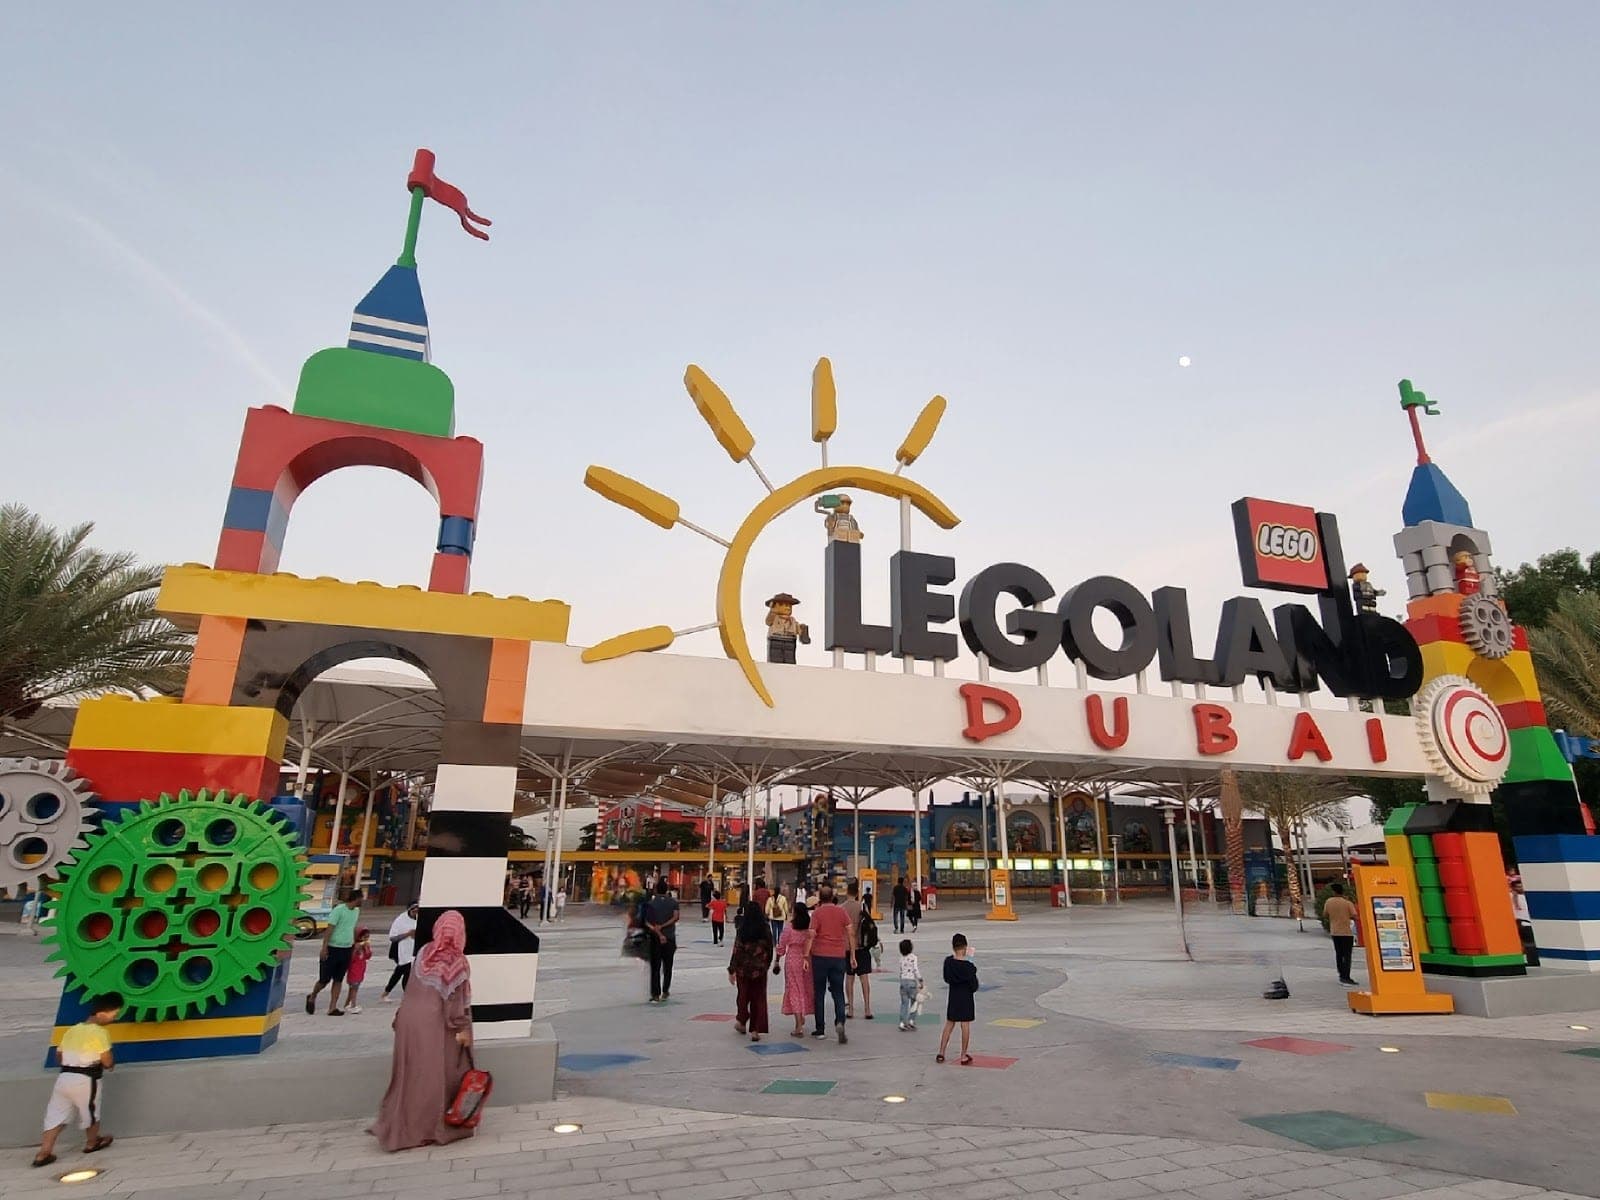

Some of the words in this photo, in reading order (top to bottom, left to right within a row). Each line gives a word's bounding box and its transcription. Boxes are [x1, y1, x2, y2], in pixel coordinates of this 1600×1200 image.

[1257, 523, 1318, 563] LEGO
[824, 540, 1424, 700] LEGOLAND
[960, 683, 1387, 763] DUBAI
